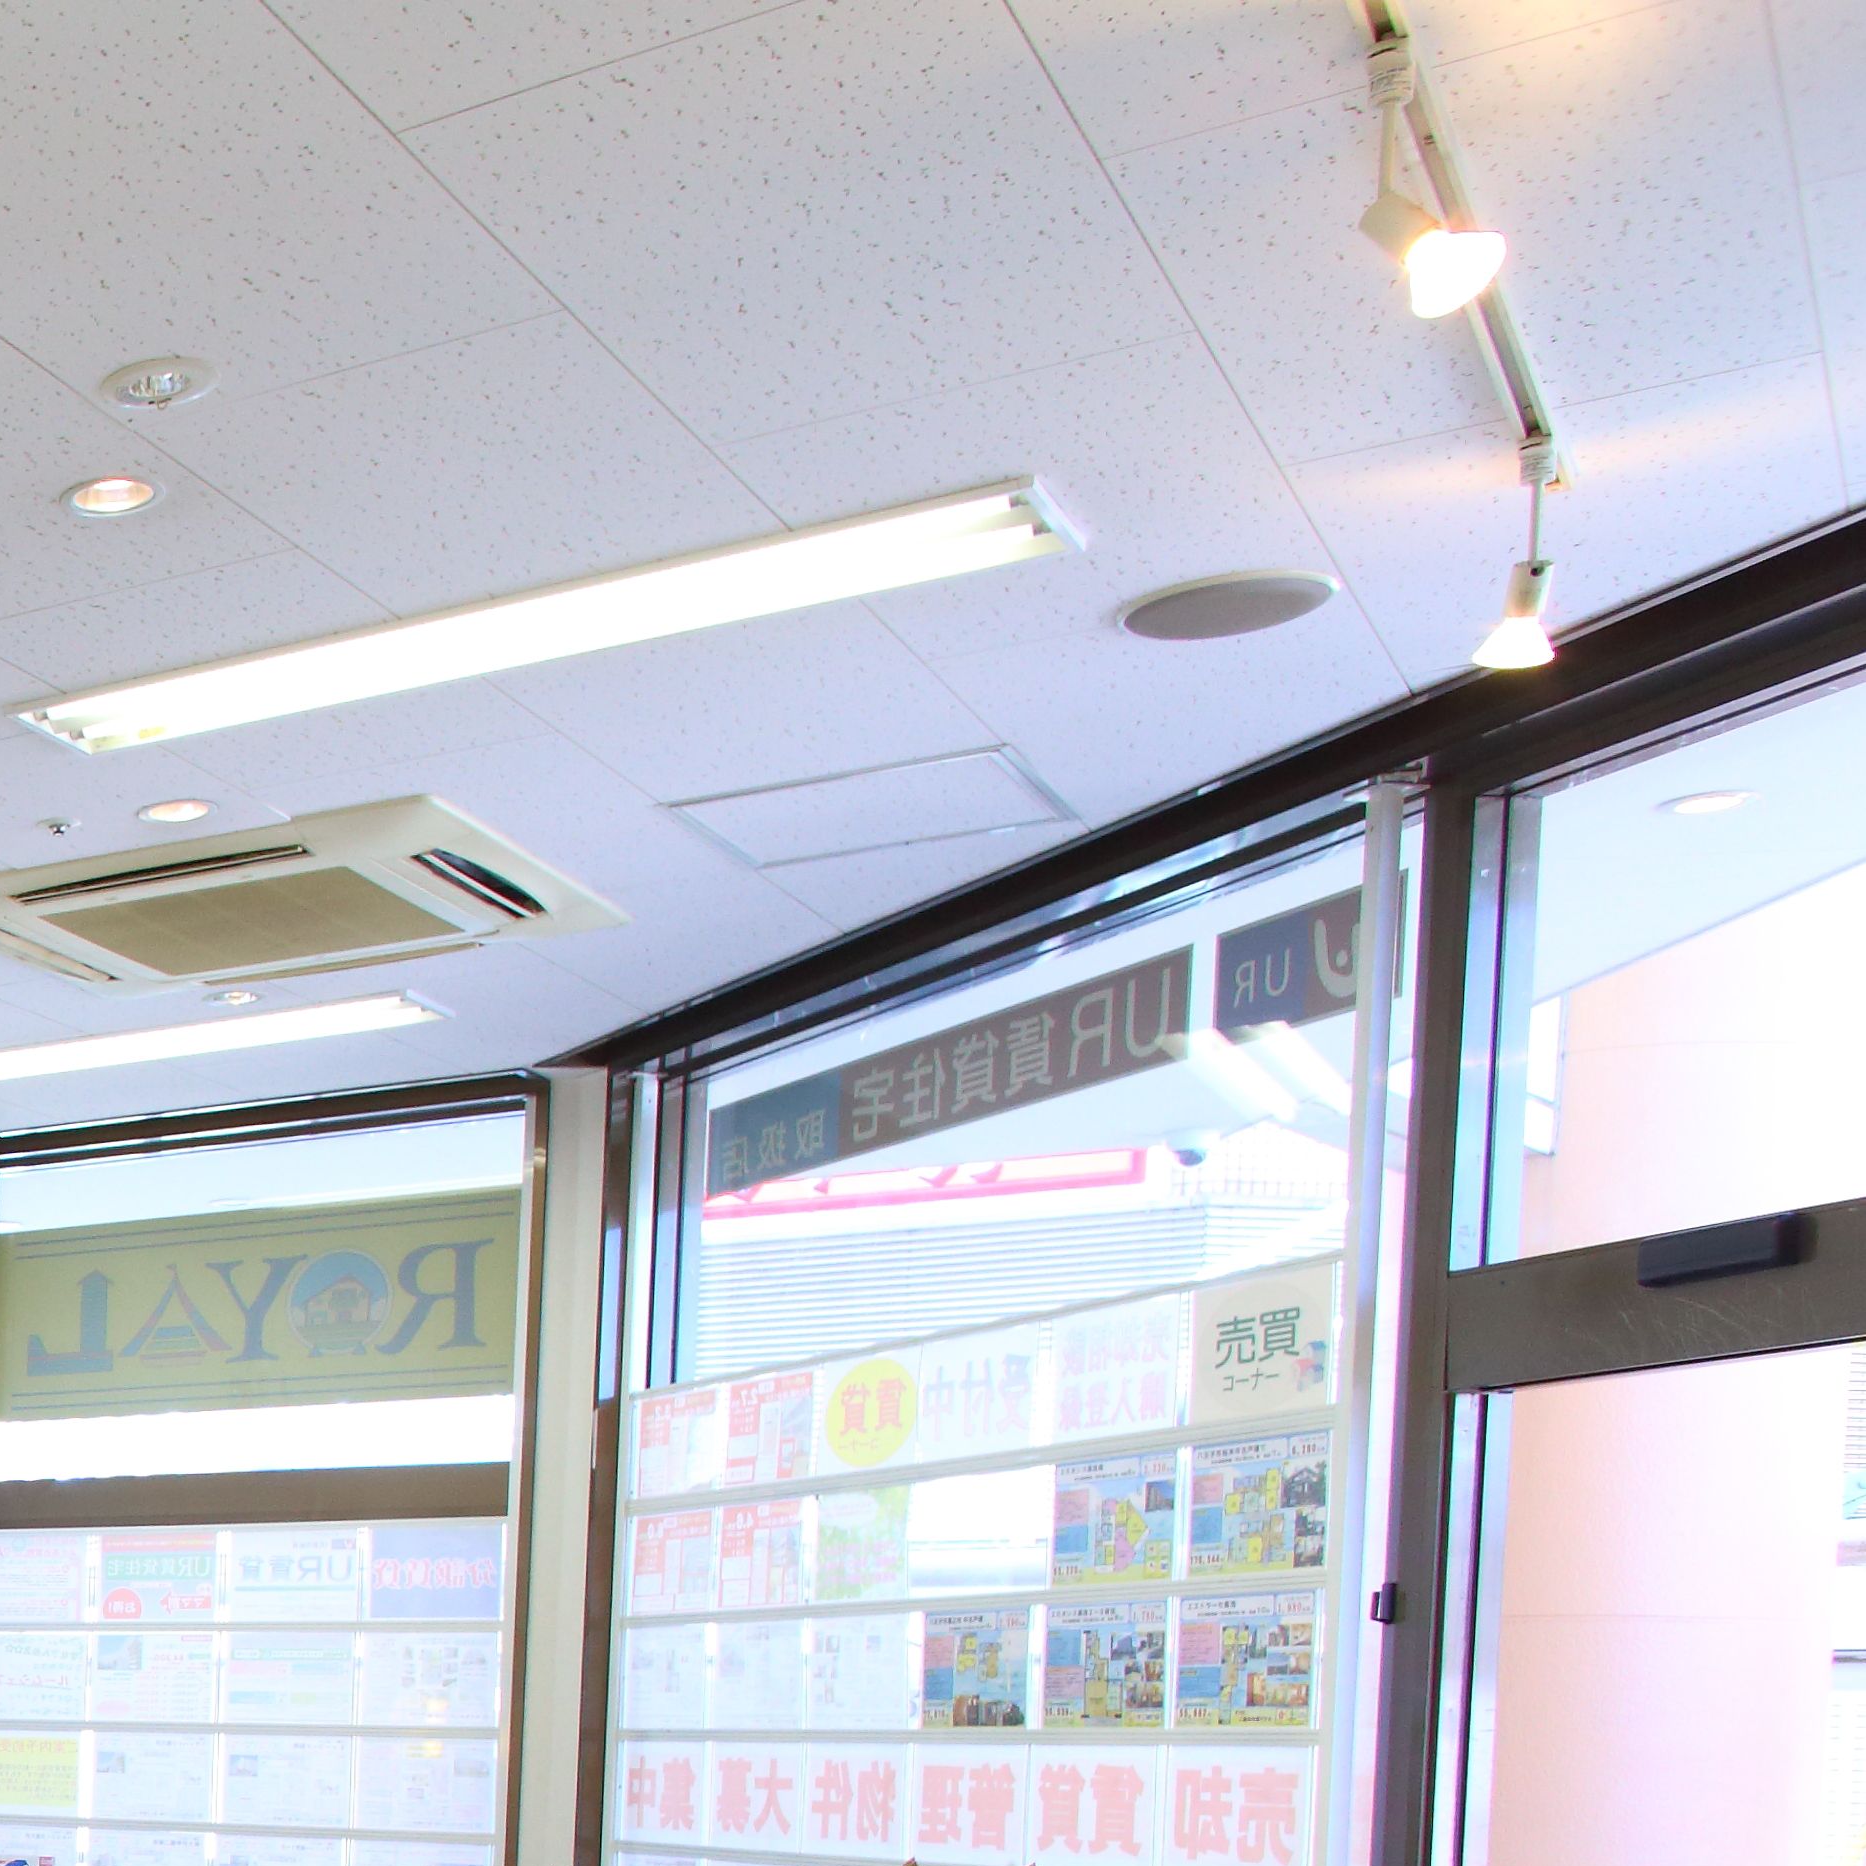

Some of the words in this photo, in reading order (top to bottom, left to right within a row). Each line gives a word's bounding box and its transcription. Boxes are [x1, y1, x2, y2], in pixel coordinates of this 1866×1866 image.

[1215, 1305, 1302, 1371] 売買
[1221, 1368, 1281, 1394] コーナー
